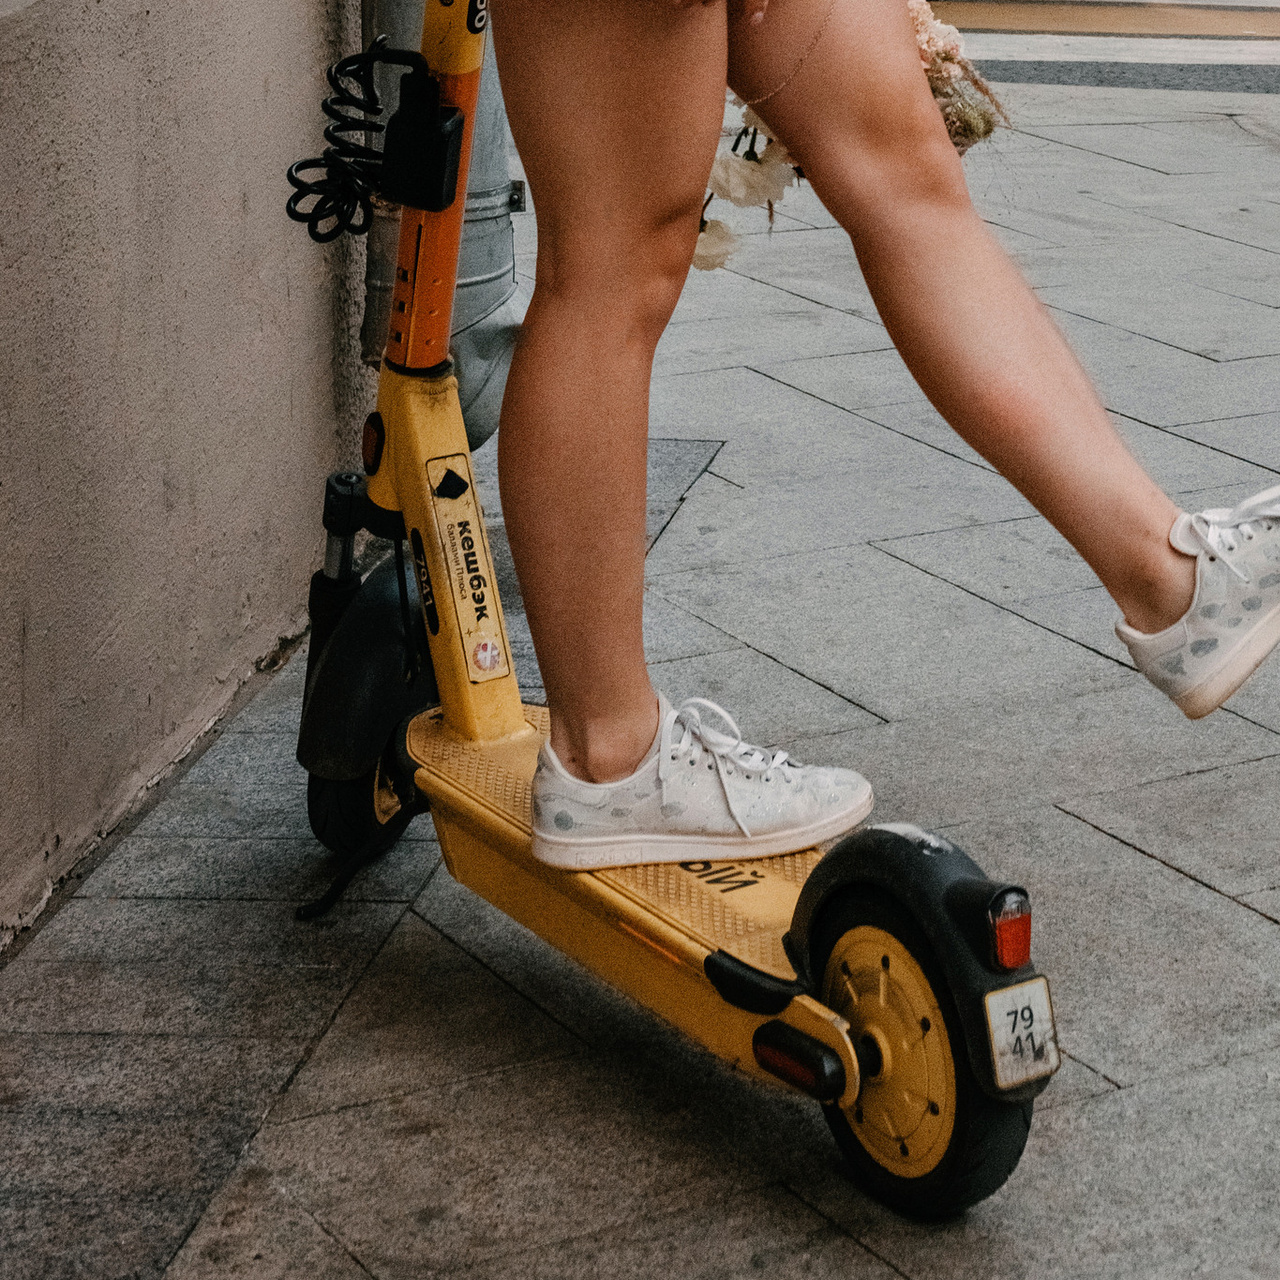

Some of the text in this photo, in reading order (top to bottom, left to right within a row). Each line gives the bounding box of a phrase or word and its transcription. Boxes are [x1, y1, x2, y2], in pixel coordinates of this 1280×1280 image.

[416, 553, 433, 606] 7941
[458, 521, 489, 622] кешбэк
[1006, 1006, 1034, 1033] 79
[1012, 1032, 1036, 1062] 41
